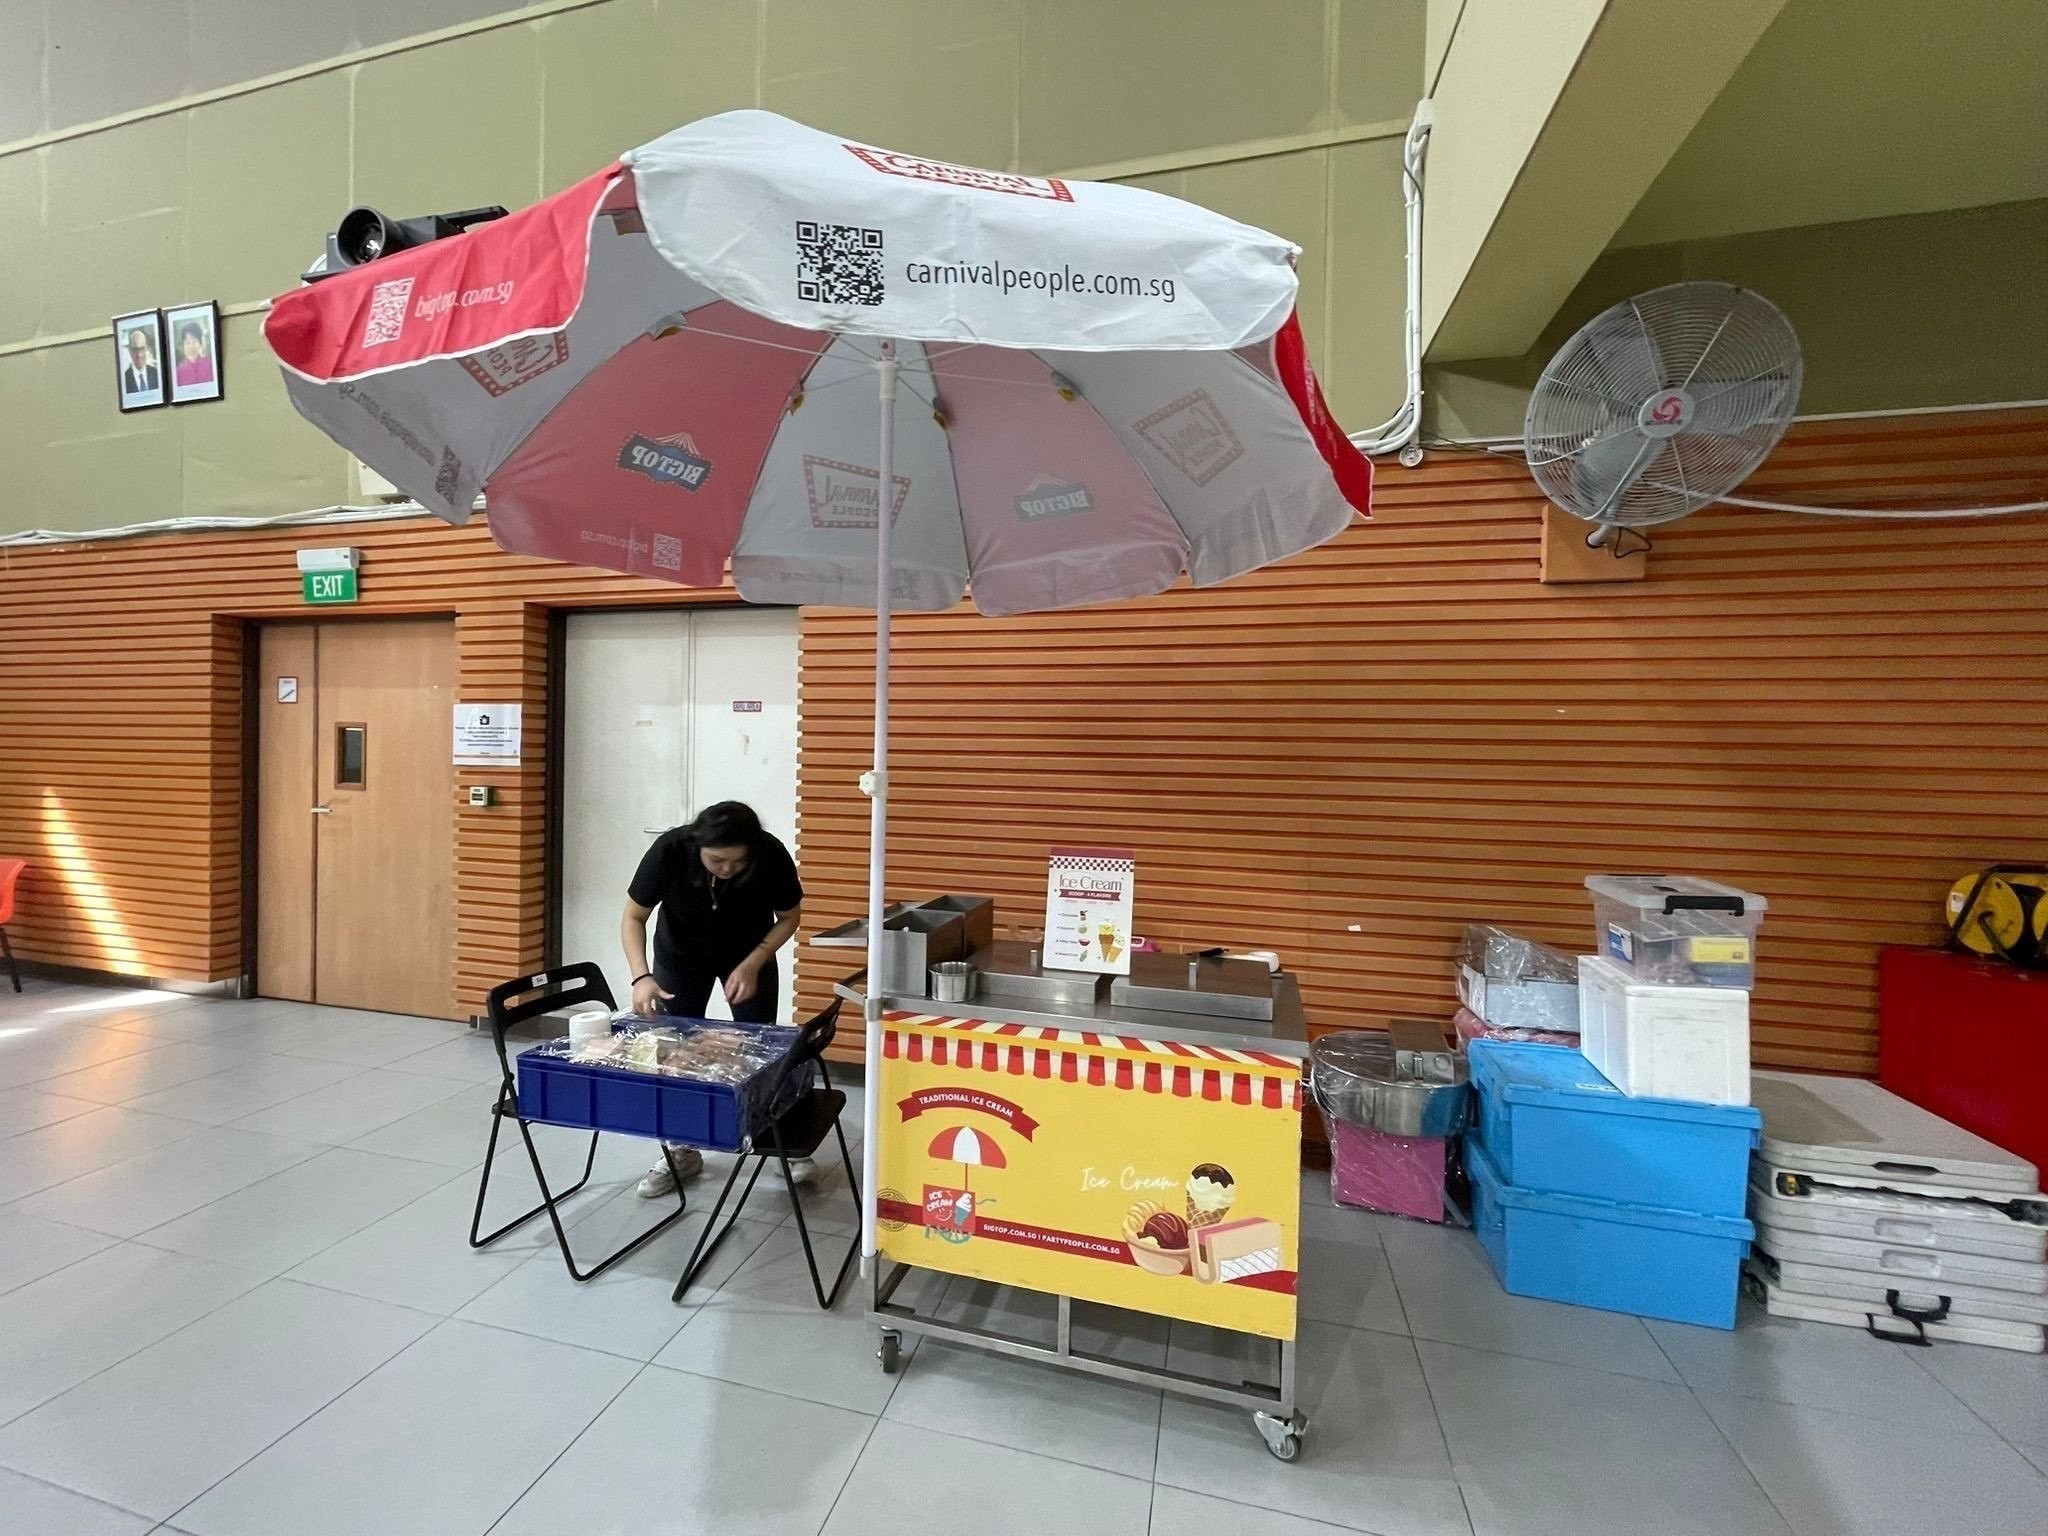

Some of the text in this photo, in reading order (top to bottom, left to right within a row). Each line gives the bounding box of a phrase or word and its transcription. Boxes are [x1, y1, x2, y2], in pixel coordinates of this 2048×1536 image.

[906, 260, 1176, 303] carnivalpeople.com.sg
[312, 575, 344, 597] EXIT
[1059, 874, 1122, 891] Ice Cream
[919, 1093, 1014, 1118] TRADITIONAL ICE CREAM
[1080, 1165, 1179, 1192] Ice Cream
[926, 1199, 953, 1213] CREAM
[928, 1190, 943, 1201] ICE
[983, 1223, 1037, 1241] BIGTOP.COM.SG
[1042, 1234, 1121, 1255] PARTYPEOPLE.COM.SG
